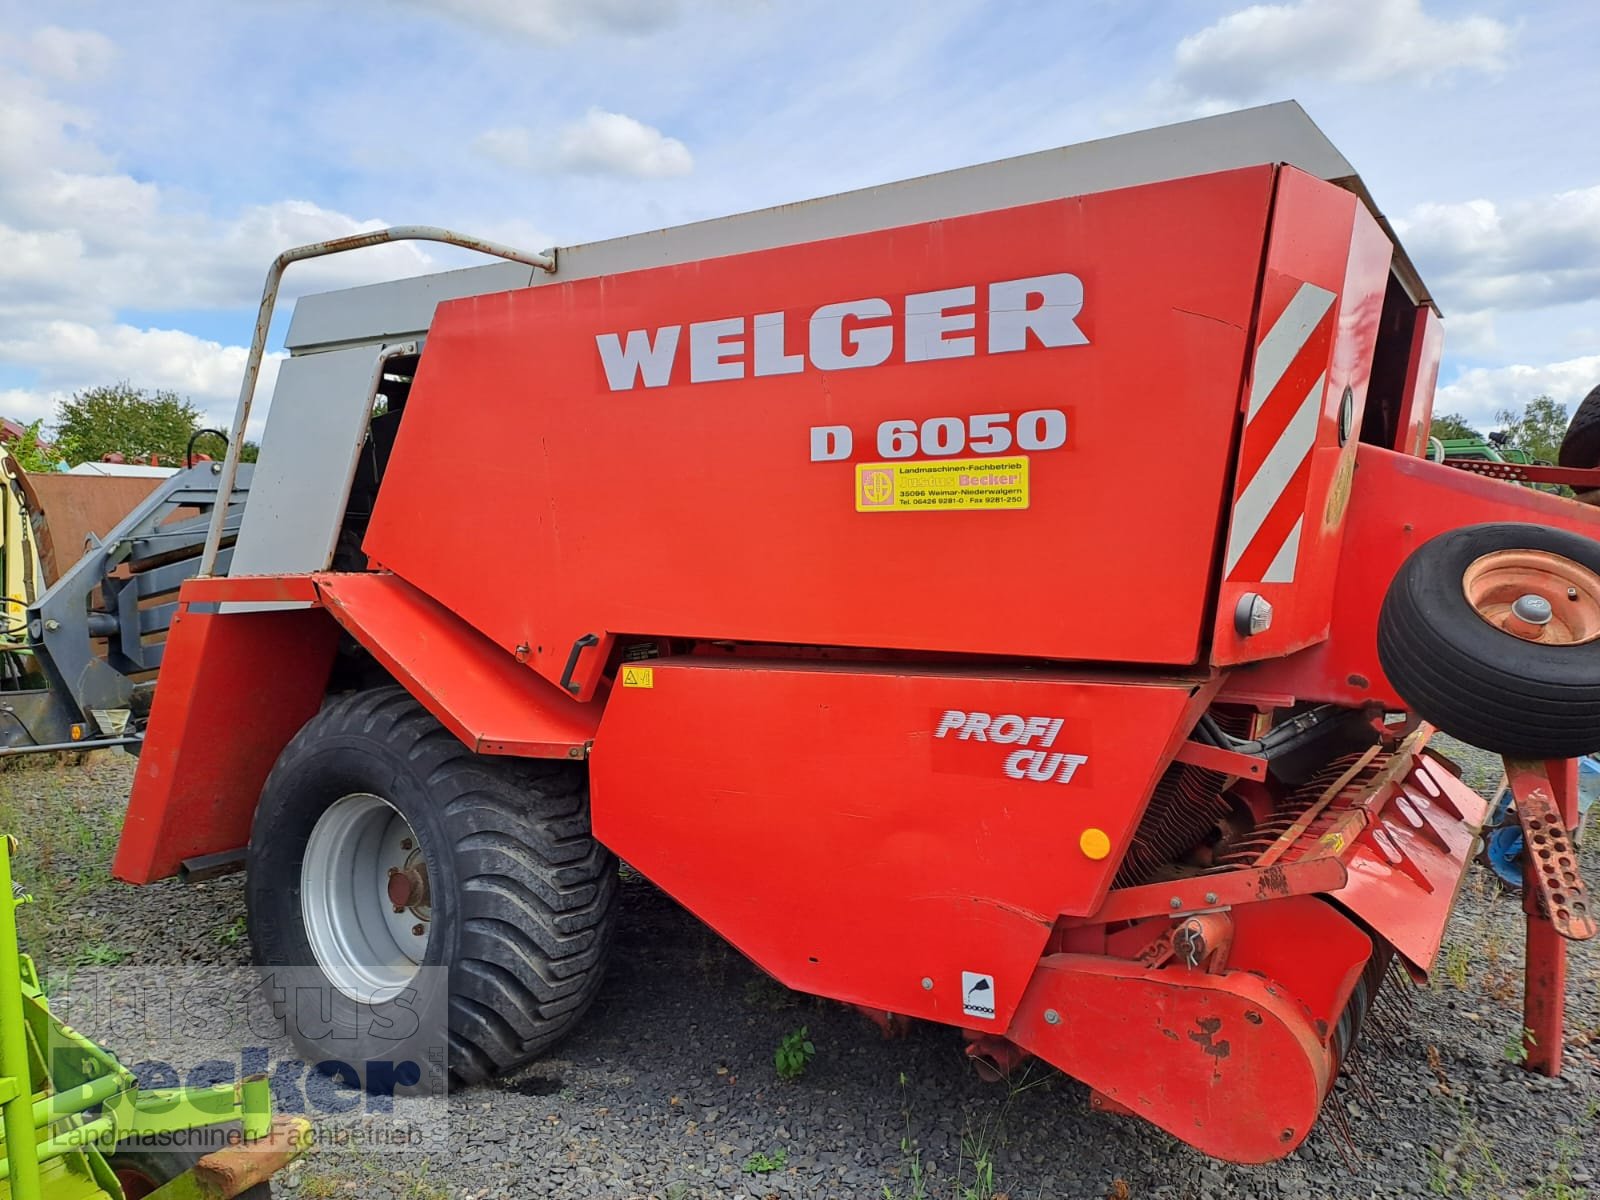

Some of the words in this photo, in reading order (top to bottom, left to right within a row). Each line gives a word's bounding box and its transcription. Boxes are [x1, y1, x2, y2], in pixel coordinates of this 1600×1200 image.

[595, 272, 1090, 391] WELGER
[810, 425, 853, 462] D
[877, 409, 1067, 458] 6050
[900, 464, 1022, 474] Landmaschinen-Fachbetrieb
[959, 474, 1016, 486] Becker
[928, 488, 1022, 498] Weimar-Niederwalgern
[933, 710, 1064, 747] PROFI
[1002, 749, 1088, 784] CUT
